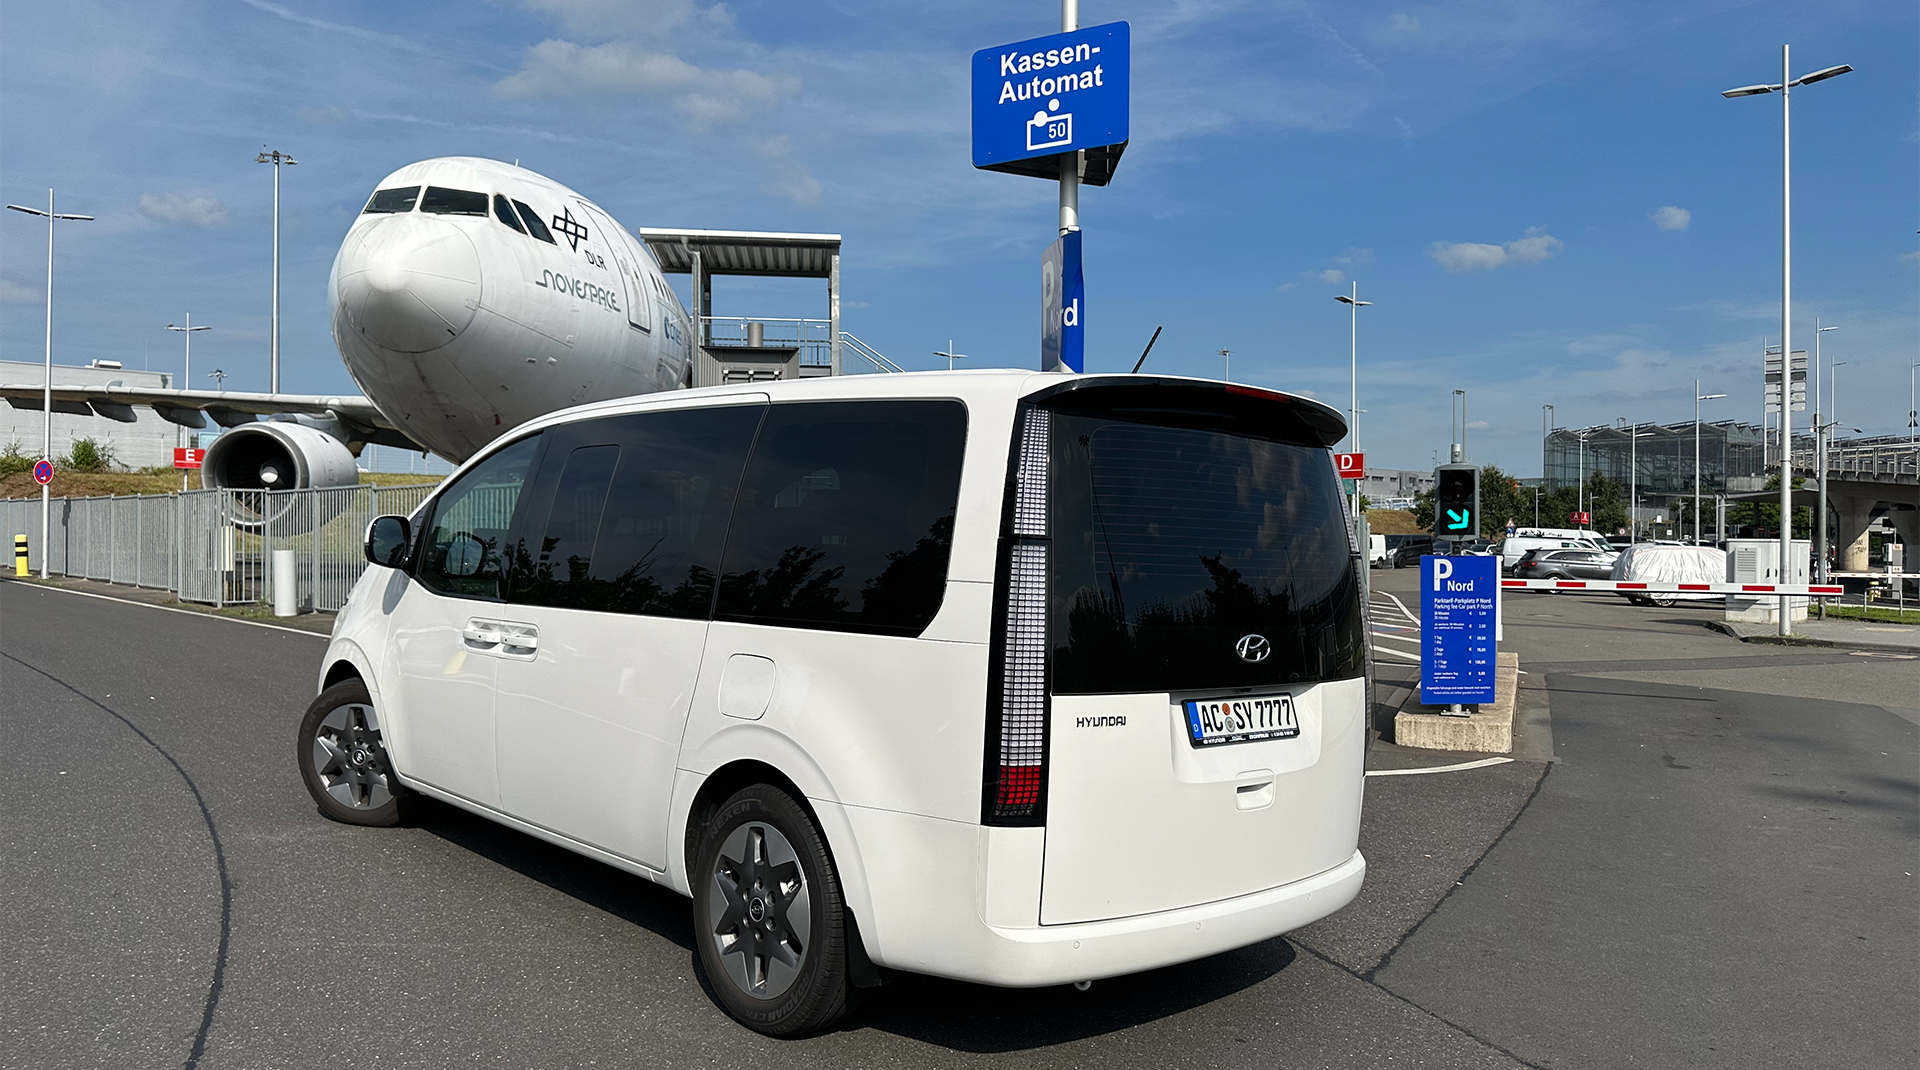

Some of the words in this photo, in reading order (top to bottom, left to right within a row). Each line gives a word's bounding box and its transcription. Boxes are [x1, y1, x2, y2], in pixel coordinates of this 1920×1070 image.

[1000, 43, 1101, 77] Kassen-
[998, 64, 1103, 105] Automat
[1048, 122, 1066, 139] 50
[584, 249, 608, 271] DLR
[535, 268, 622, 313] NOVESPACE
[1042, 260, 1055, 340] P
[185, 449, 195, 461] E
[1341, 454, 1353, 470] D
[1433, 558, 1453, 592] P
[1447, 580, 1474, 592] Nord
[1076, 715, 1127, 728] HYUNDAI
[1193, 723, 1199, 733] D
[1201, 704, 1224, 733] AC
[1232, 701, 1253, 729] SY
[1254, 699, 1291, 728] 7777
[710, 802, 751, 840] NEXEN
